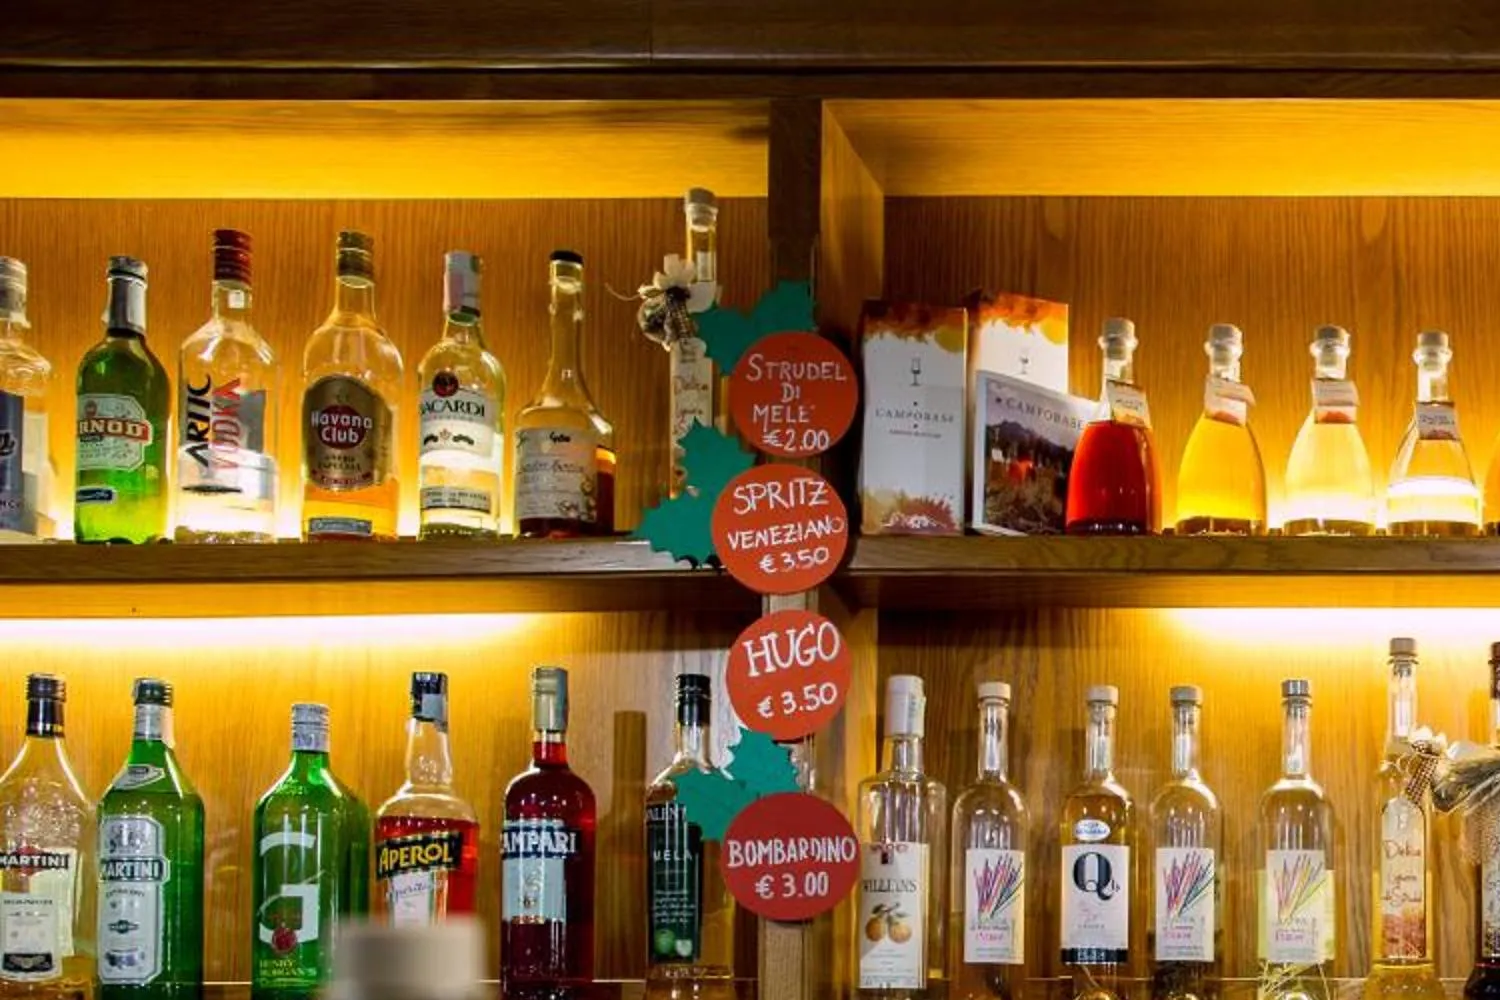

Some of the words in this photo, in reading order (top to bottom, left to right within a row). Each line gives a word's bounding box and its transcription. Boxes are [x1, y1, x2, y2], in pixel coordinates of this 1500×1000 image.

[745, 353, 847, 382] STRUDEL
[782, 382, 801, 403] DI
[310, 410, 373, 429] Havana
[321, 427, 359, 443] Club
[732, 477, 830, 515] SPRITZ
[727, 515, 845, 551] VENEZIANO
[759, 553, 777, 574] €
[743, 620, 841, 678] HUGO
[757, 696, 774, 718] €
[781, 681, 838, 716] 3.50
[500, 831, 578, 854] AMPARI
[727, 836, 857, 868] BOMBARDINO
[379, 842, 453, 875] APEROL
[754, 874, 775, 900] €
[781, 871, 829, 899] 3.00
